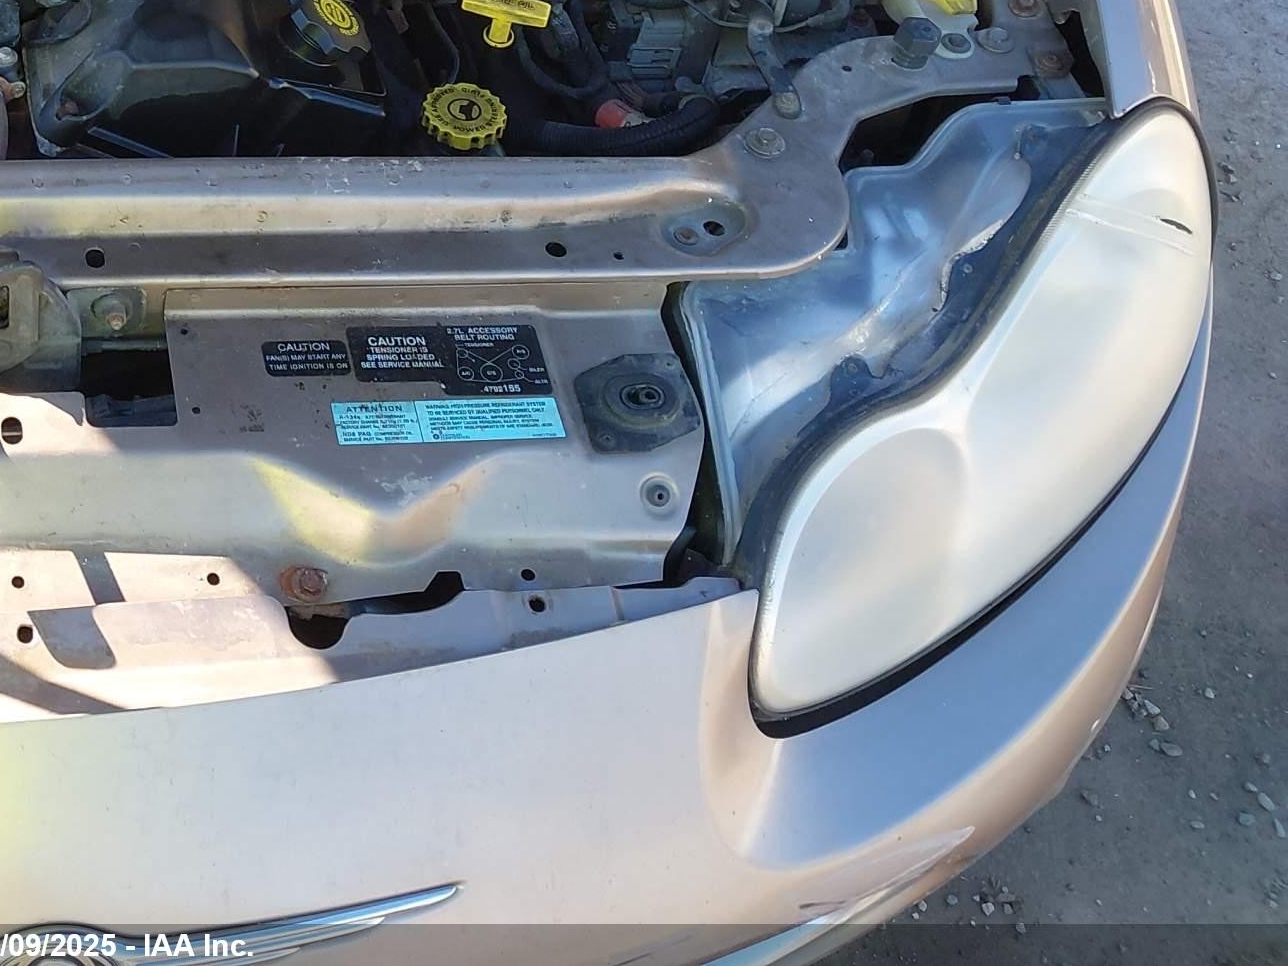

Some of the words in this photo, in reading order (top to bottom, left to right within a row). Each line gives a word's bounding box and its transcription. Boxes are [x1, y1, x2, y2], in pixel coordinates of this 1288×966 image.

[518, 1, 535, 10] OIL
[368, 336, 426, 346] CAUTION
[278, 343, 330, 352] CAUTION
